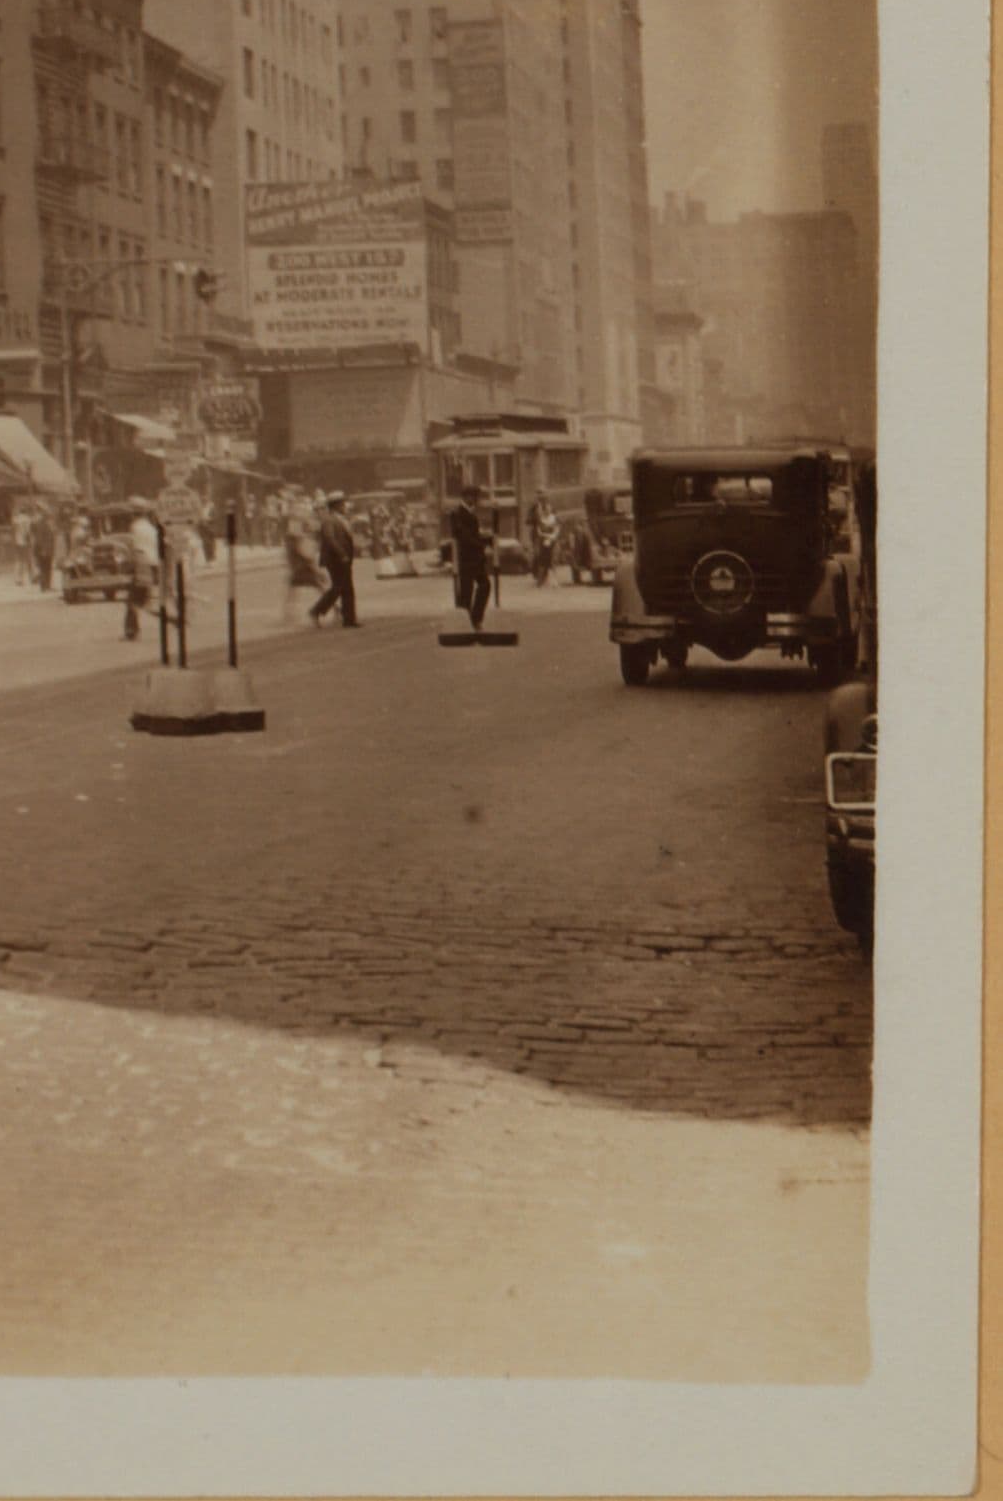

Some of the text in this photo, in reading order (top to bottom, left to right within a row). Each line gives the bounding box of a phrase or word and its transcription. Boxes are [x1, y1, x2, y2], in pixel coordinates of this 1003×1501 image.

[276, 271, 397, 288] SPLENDID HOMES
[253, 285, 420, 305] AT MODERATE RENTALS
[265, 319, 370, 334] RESERVATIONS
